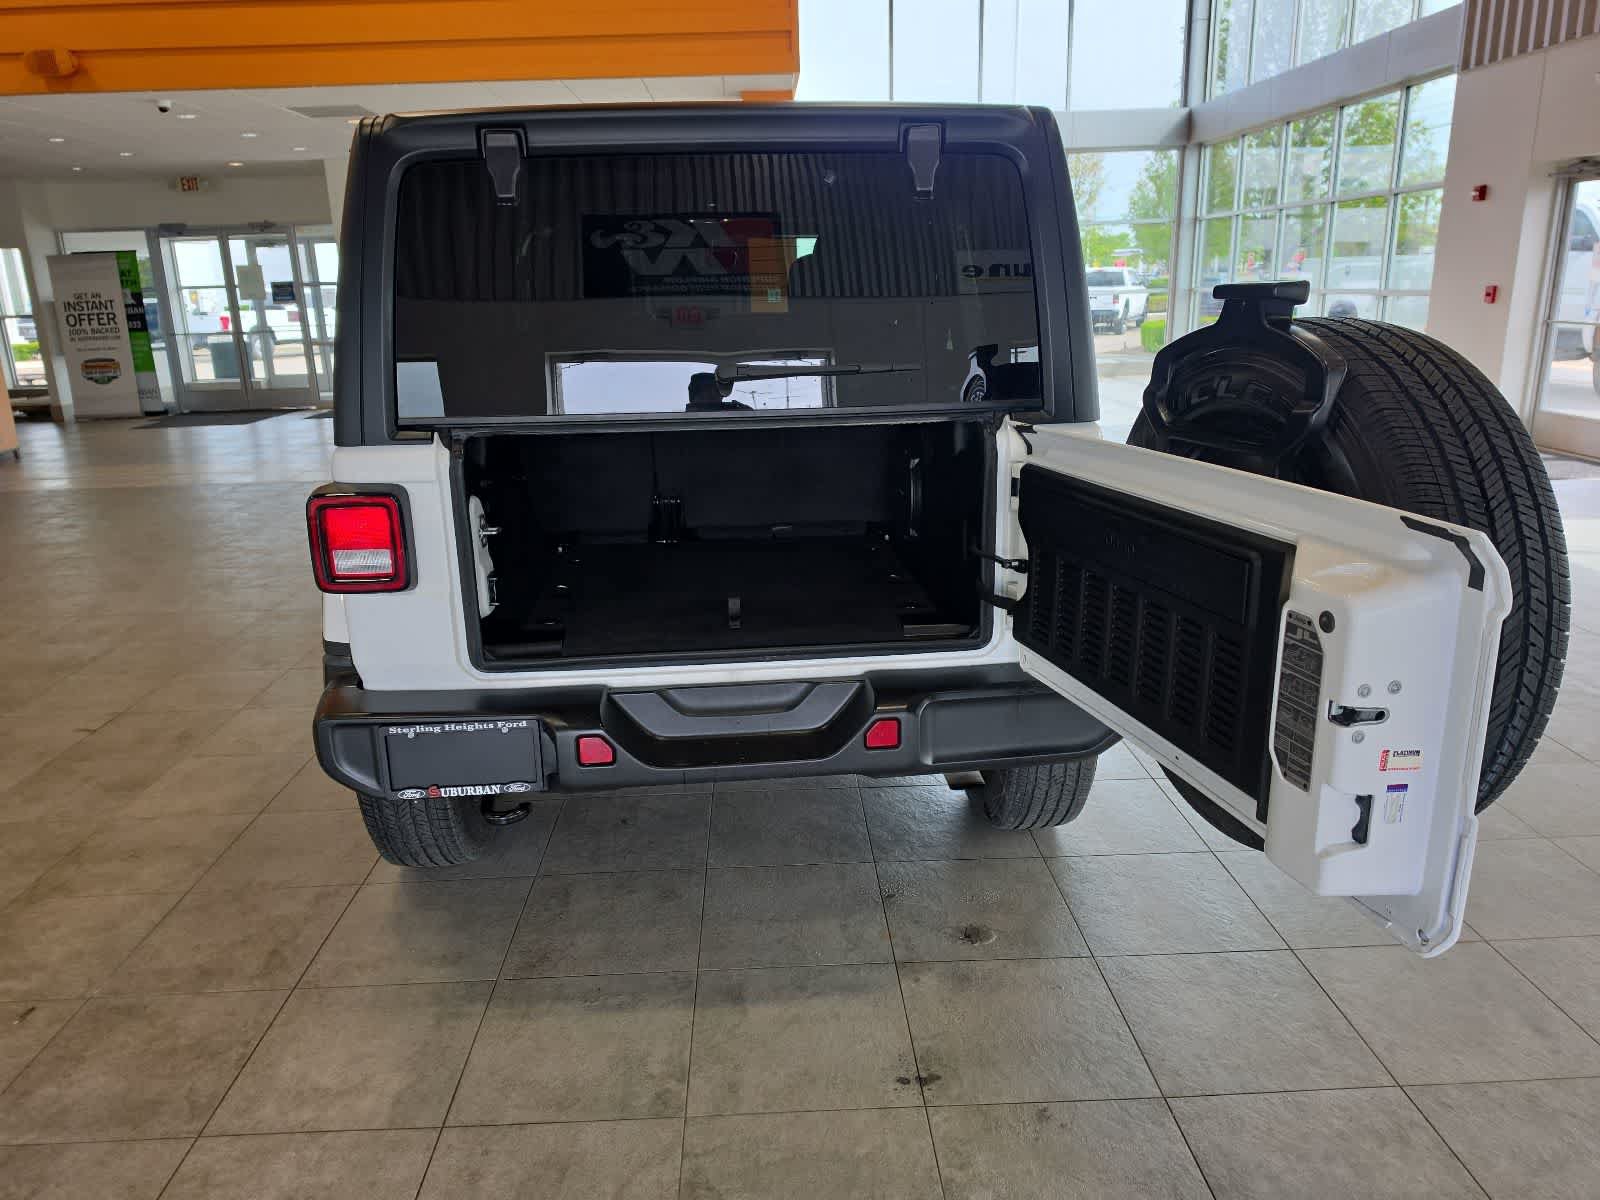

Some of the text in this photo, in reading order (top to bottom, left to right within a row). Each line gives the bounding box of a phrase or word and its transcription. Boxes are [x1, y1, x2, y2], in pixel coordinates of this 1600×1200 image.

[181, 176, 199, 192] EXIT
[73, 291, 102, 300] GET AN
[63, 299, 115, 312] INSTANT
[65, 311, 118, 328] OFFER
[69, 327, 120, 336] 100% BACKED
[388, 720, 527, 734] Sterling Heights Ford
[398, 783, 530, 799] Ford SUBURBAN Ford
